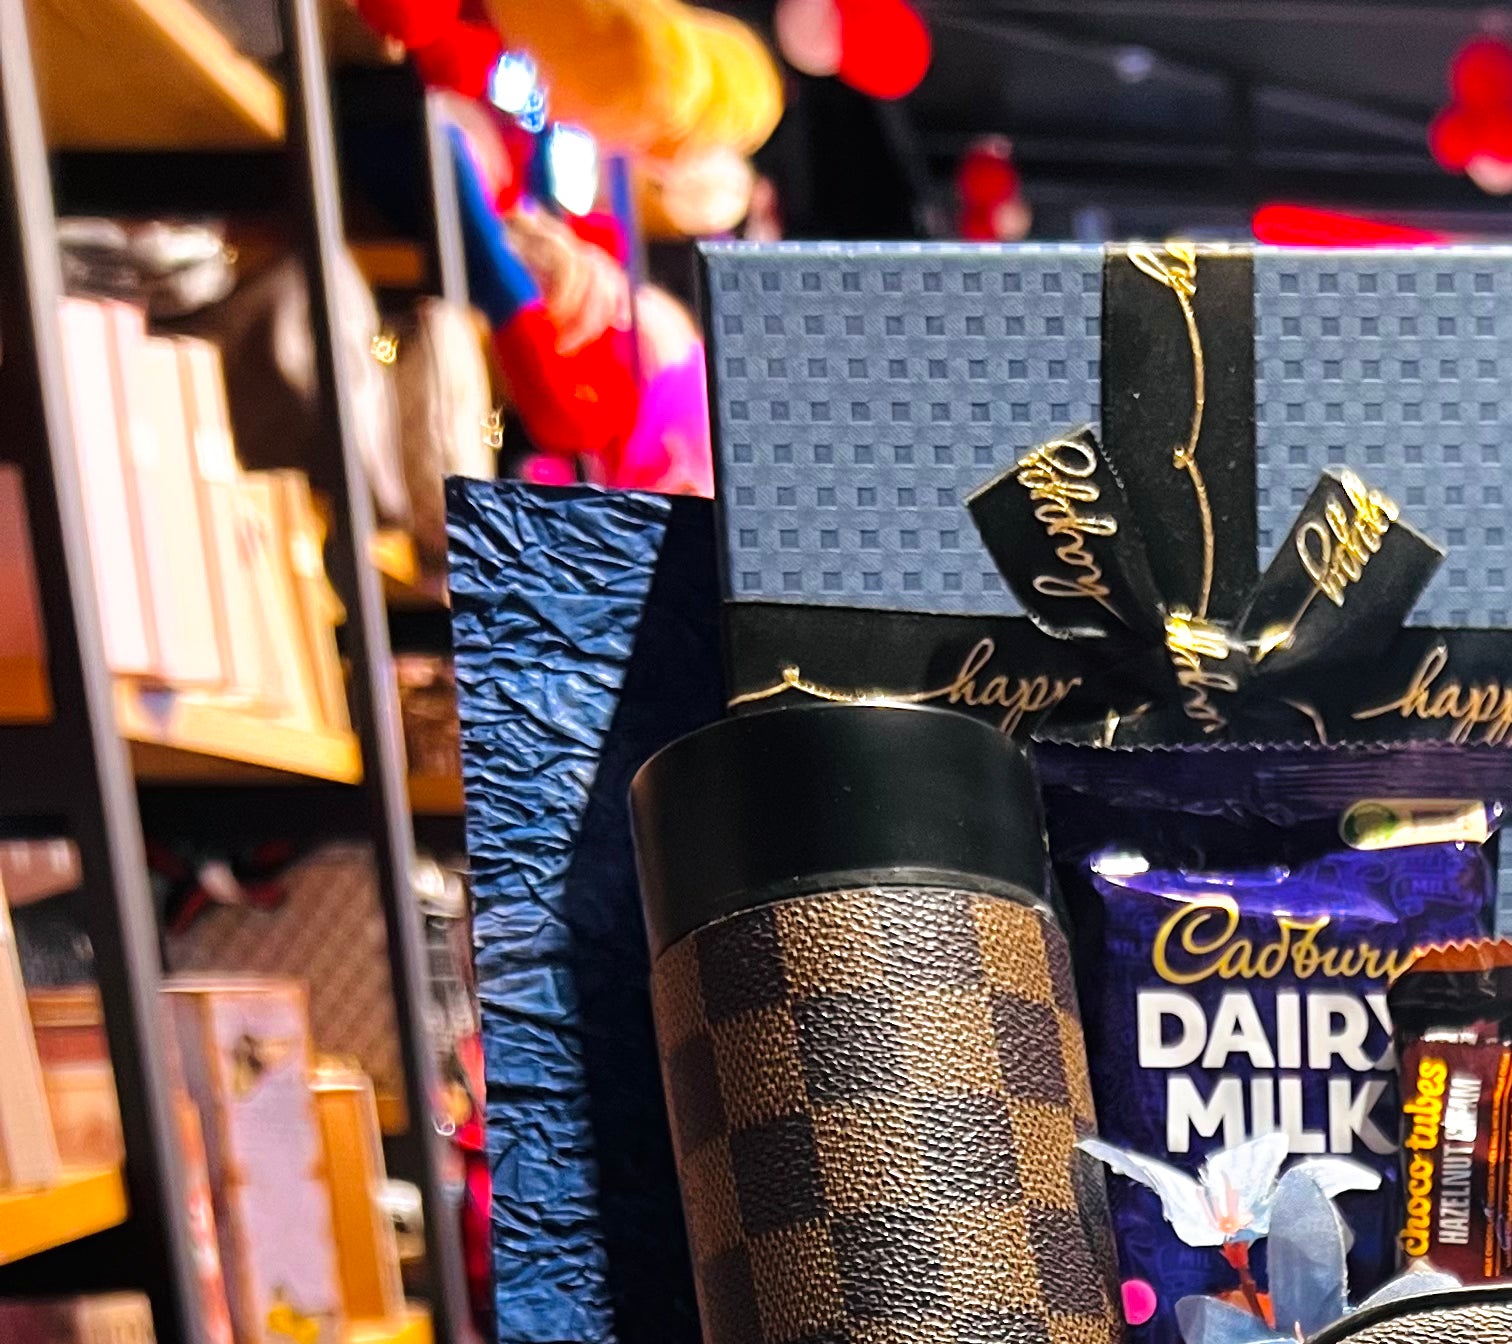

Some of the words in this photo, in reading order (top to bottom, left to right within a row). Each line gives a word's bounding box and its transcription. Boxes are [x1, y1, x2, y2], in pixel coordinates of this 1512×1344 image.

[1166, 1075, 1399, 1155] MILK
[1403, 1057, 1449, 1152] tubes
[1438, 1141, 1475, 1245] HAZELNUT
